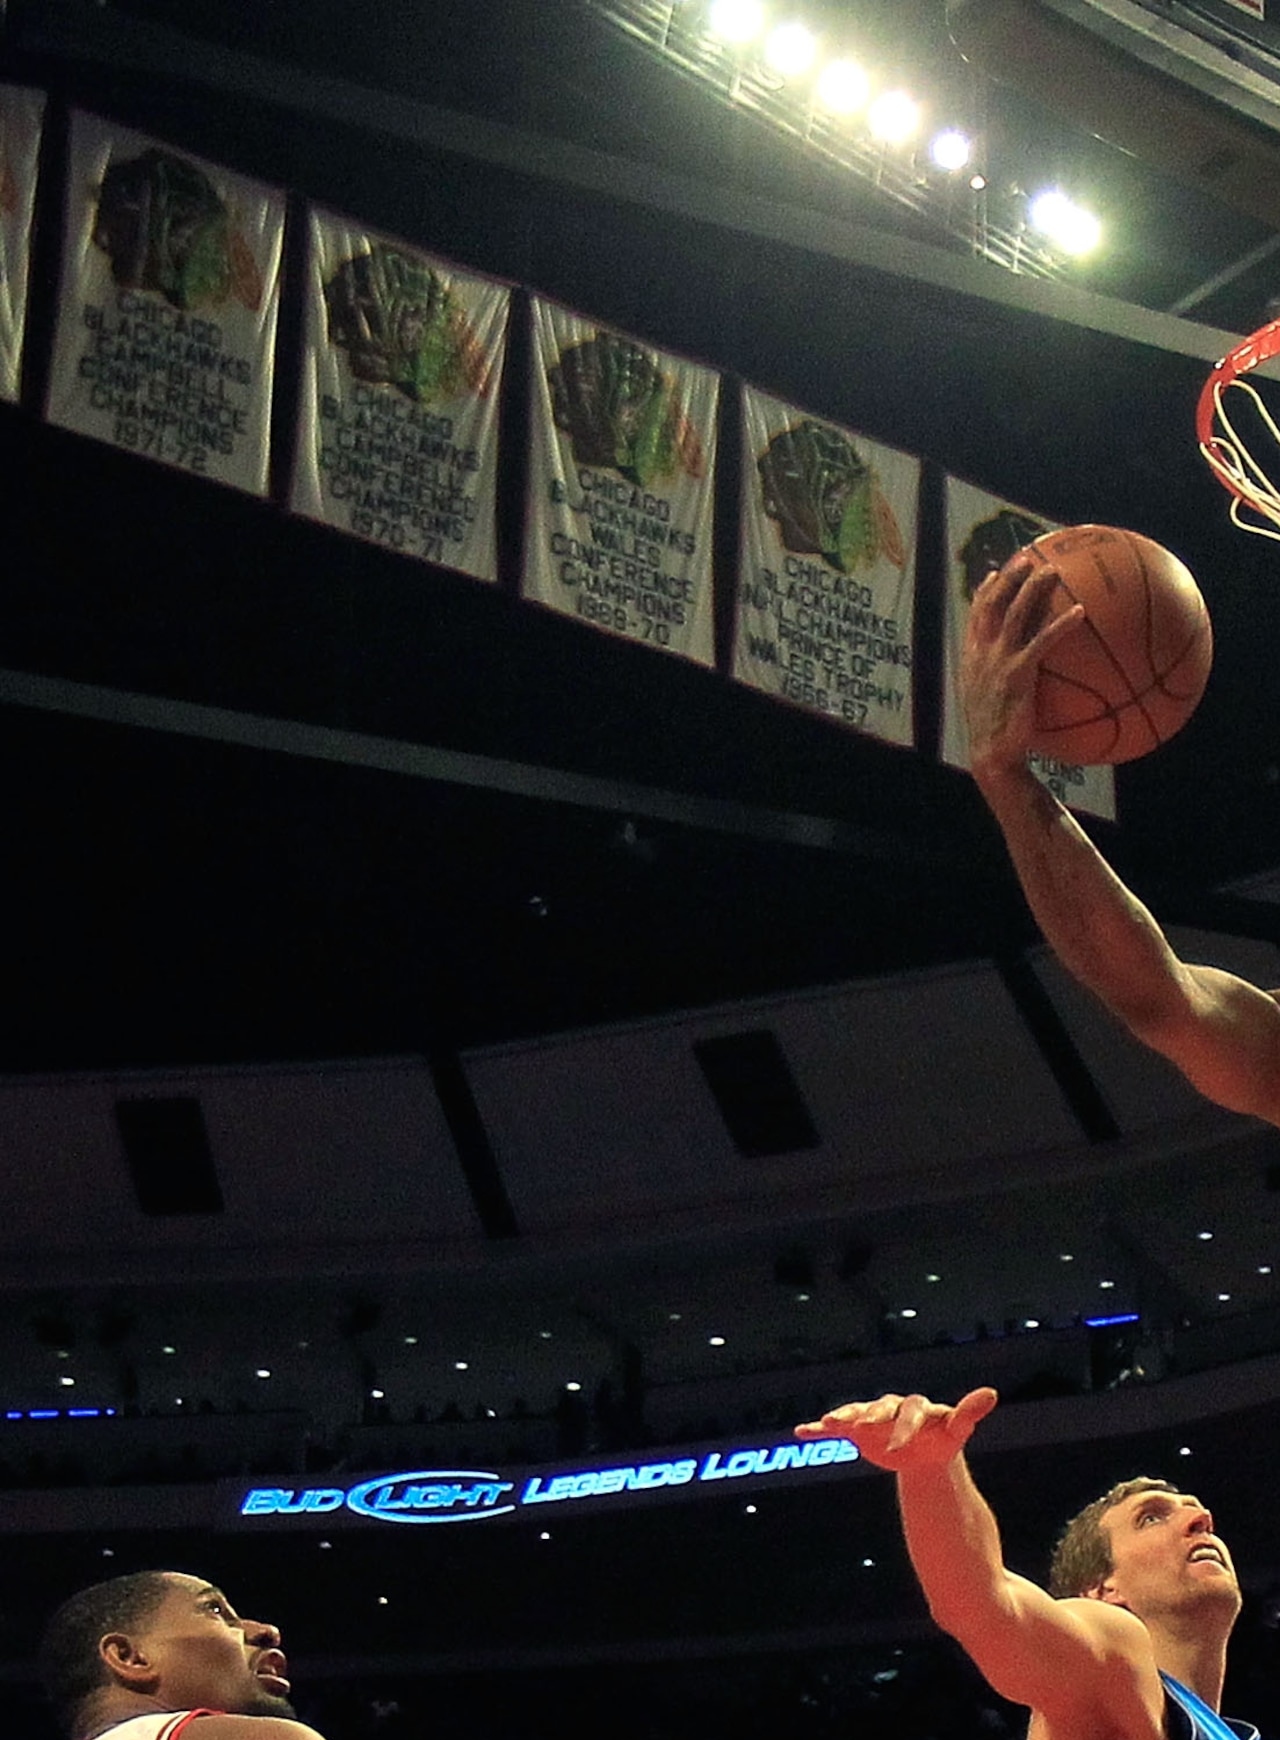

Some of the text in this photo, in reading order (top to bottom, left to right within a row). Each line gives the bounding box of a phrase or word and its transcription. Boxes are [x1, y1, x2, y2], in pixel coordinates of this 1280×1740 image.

[580, 469, 670, 521] CHICAGO
[552, 533, 695, 604] CONFERENCE
[592, 521, 661, 567] WALES
[562, 561, 686, 625] CHAMPIONS
[761, 568, 898, 640] BLACKHAWKS
[785, 556, 873, 609] CHICAGO
[797, 607, 910, 669] CHAMPIONS
[851, 653, 878, 679] OF
[822, 663, 905, 712] TROPHY
[241, 1438, 860, 1516] BUD LIGHT LEGENDS LOUNGE
